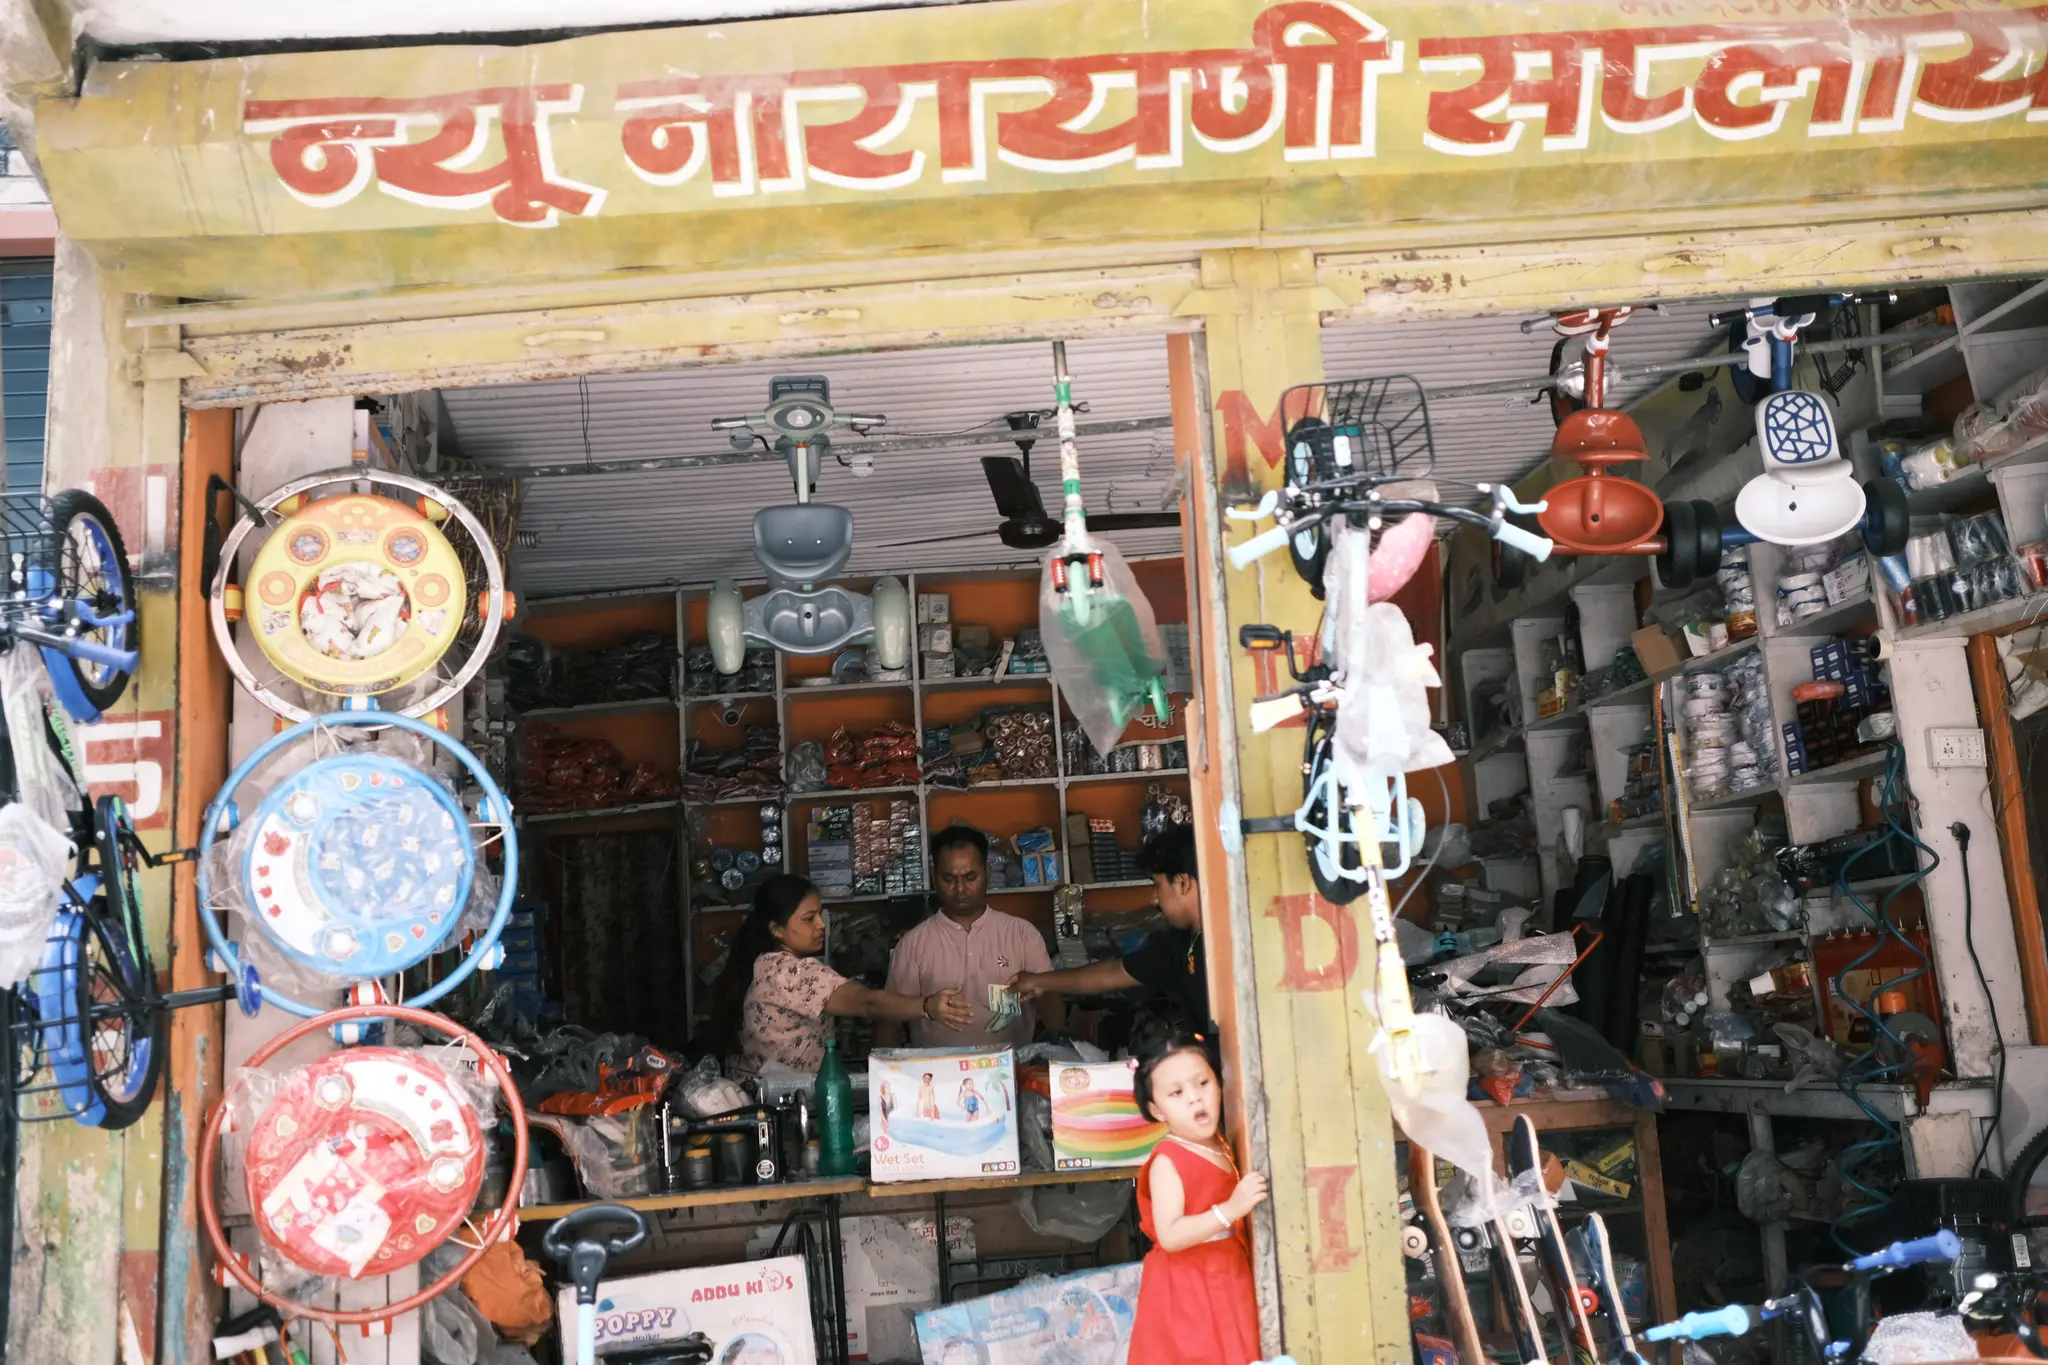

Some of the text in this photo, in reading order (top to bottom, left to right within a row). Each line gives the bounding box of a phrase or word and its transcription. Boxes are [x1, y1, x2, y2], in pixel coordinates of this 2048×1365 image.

[244, 83, 609, 228] न्यू
[614, 0, 1404, 196] नारायणी
[959, 1055, 1009, 1071] INTEX
[874, 1153, 925, 1165] Wet Set
[594, 1307, 677, 1339] POPPY
